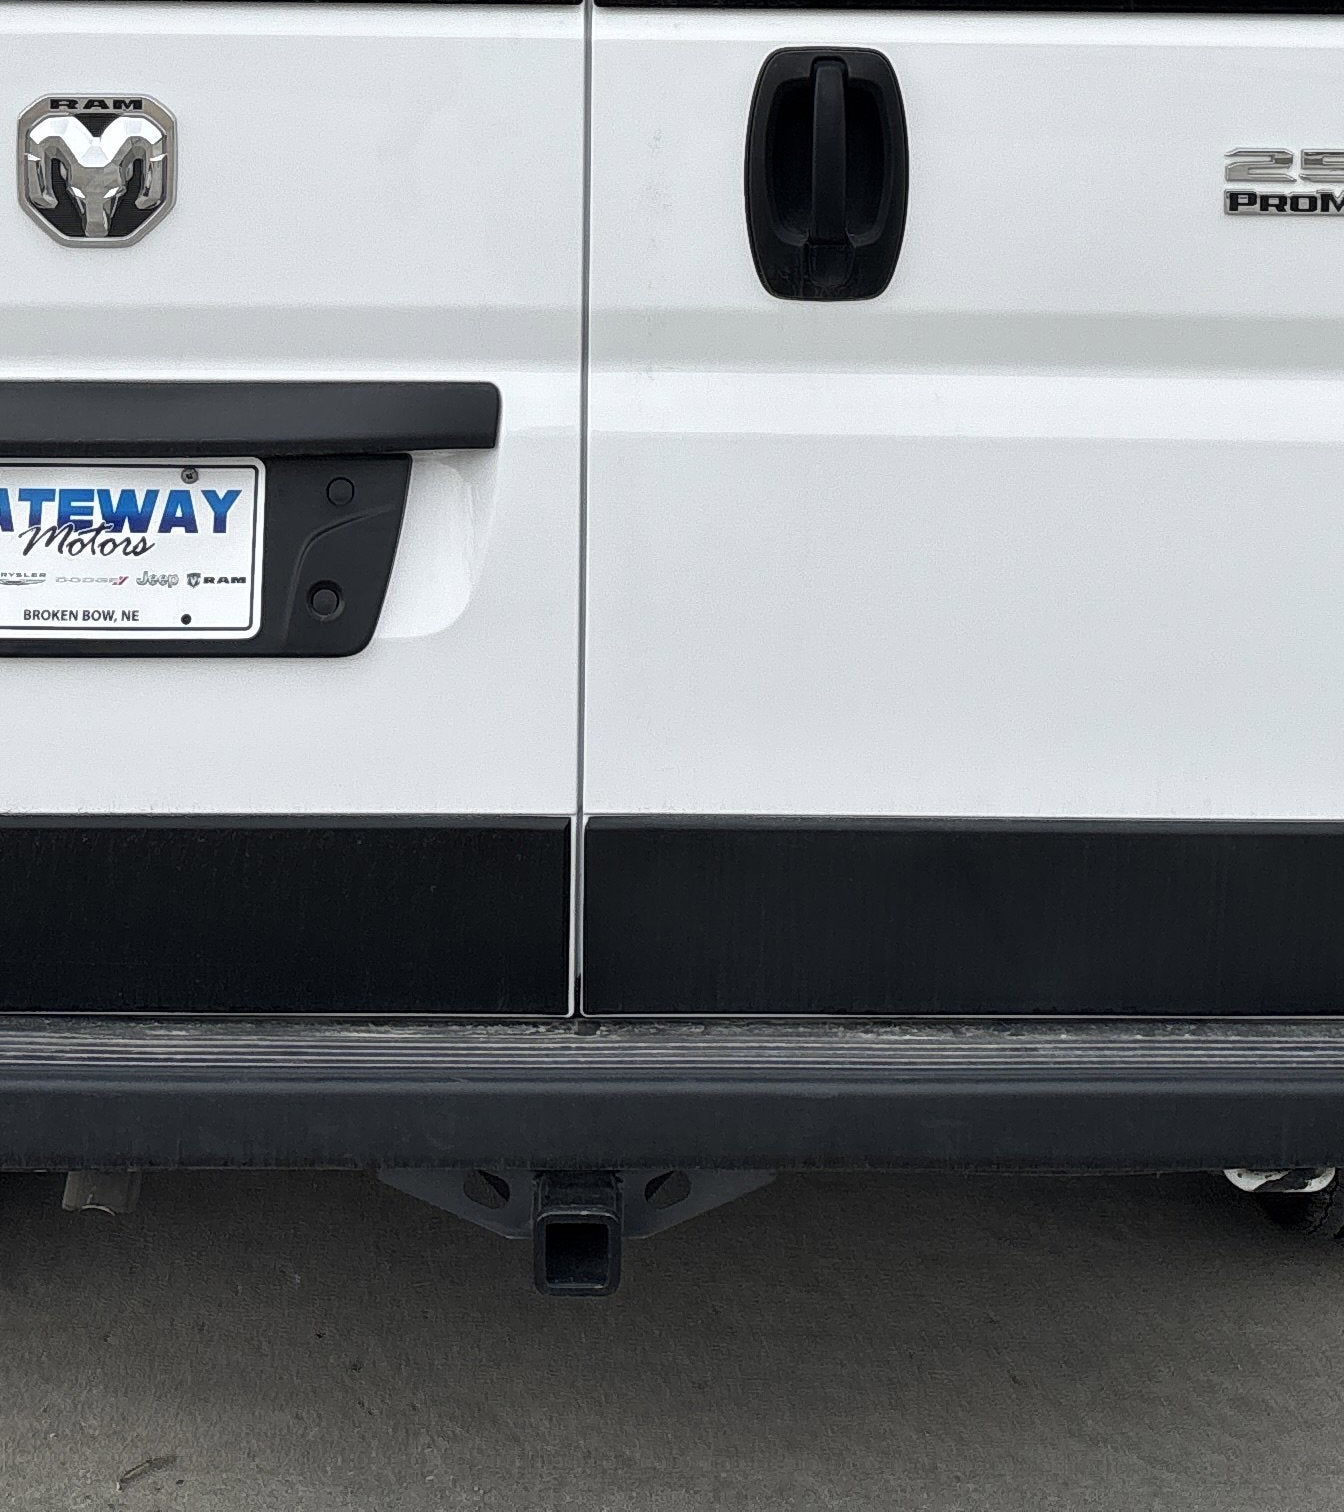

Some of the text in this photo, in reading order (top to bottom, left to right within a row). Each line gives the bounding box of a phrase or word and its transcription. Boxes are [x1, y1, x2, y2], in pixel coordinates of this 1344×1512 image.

[49, 98, 143, 110] RAM
[18, 521, 156, 558] Motors
[136, 570, 179, 588] Jeep
[203, 576, 247, 584] RAM
[23, 609, 140, 623] BROKEN BOW, NE
